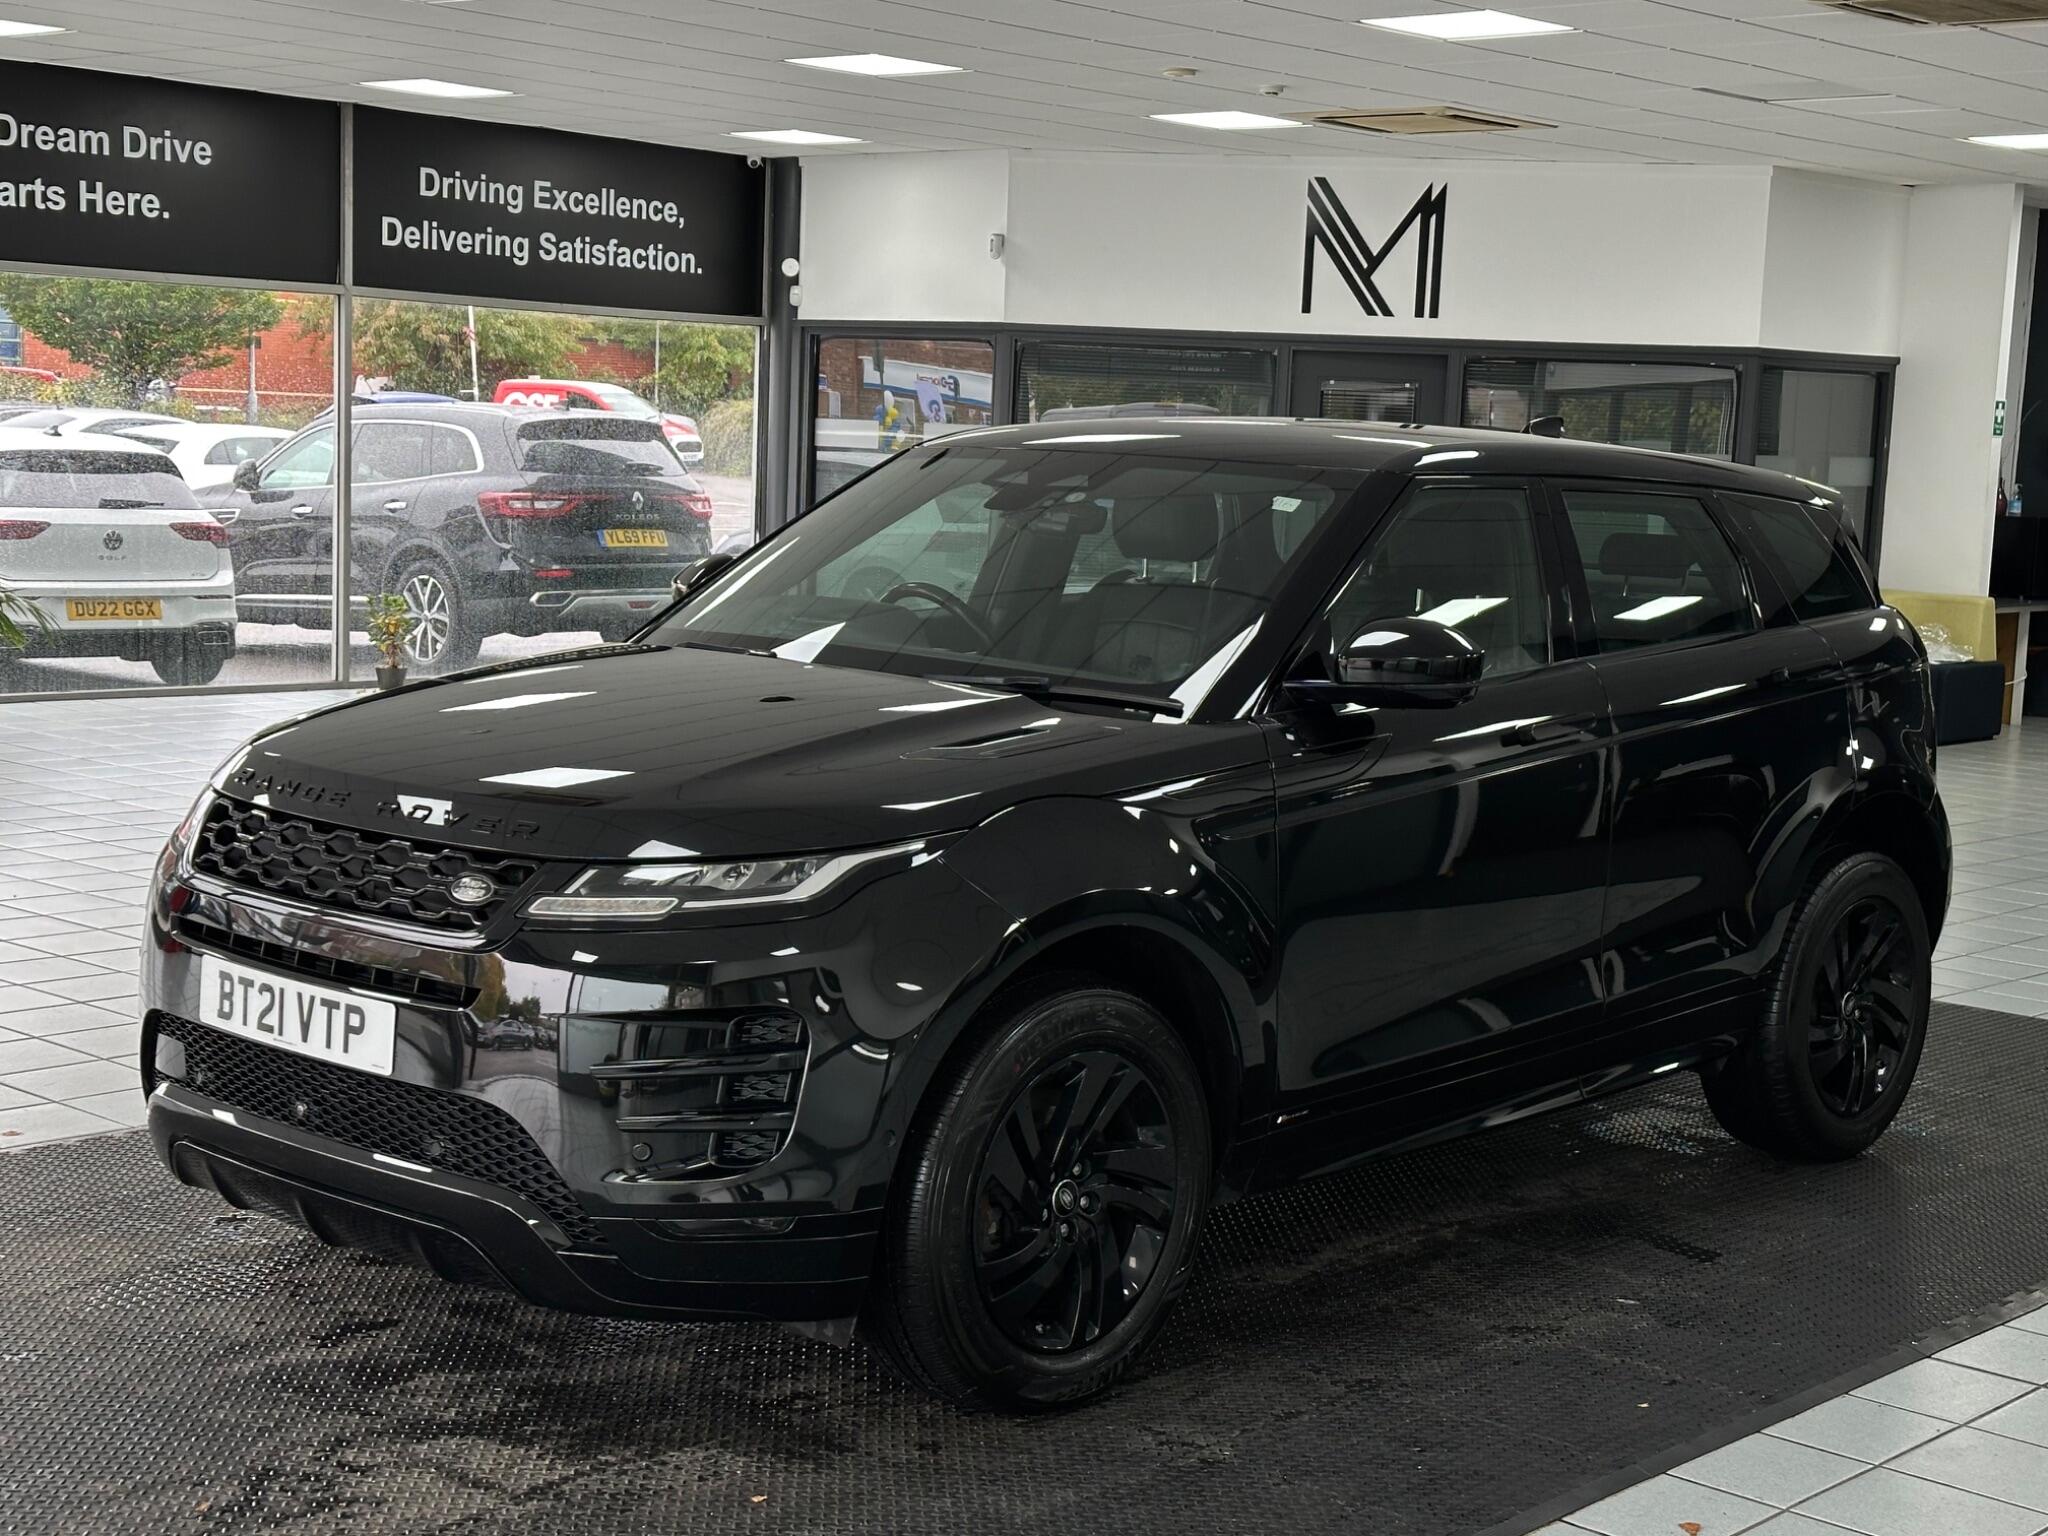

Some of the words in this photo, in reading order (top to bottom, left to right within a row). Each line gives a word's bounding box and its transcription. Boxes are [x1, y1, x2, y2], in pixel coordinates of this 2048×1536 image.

[0, 113, 110, 156] Dream
[123, 126, 212, 165] Drive
[79, 180, 170, 219] Here.
[419, 167, 523, 214] Driving
[533, 180, 685, 229] Excellence,
[381, 216, 529, 266] Delivering
[538, 232, 703, 274] Satisfaction.
[606, 530, 640, 544] YL69
[642, 530, 666, 541] FFU
[75, 601, 120, 617] DU22
[123, 601, 156, 616] GGX
[376, 798, 541, 841] ROVER
[217, 970, 285, 1037] BT21
[297, 991, 366, 1054] VTP
